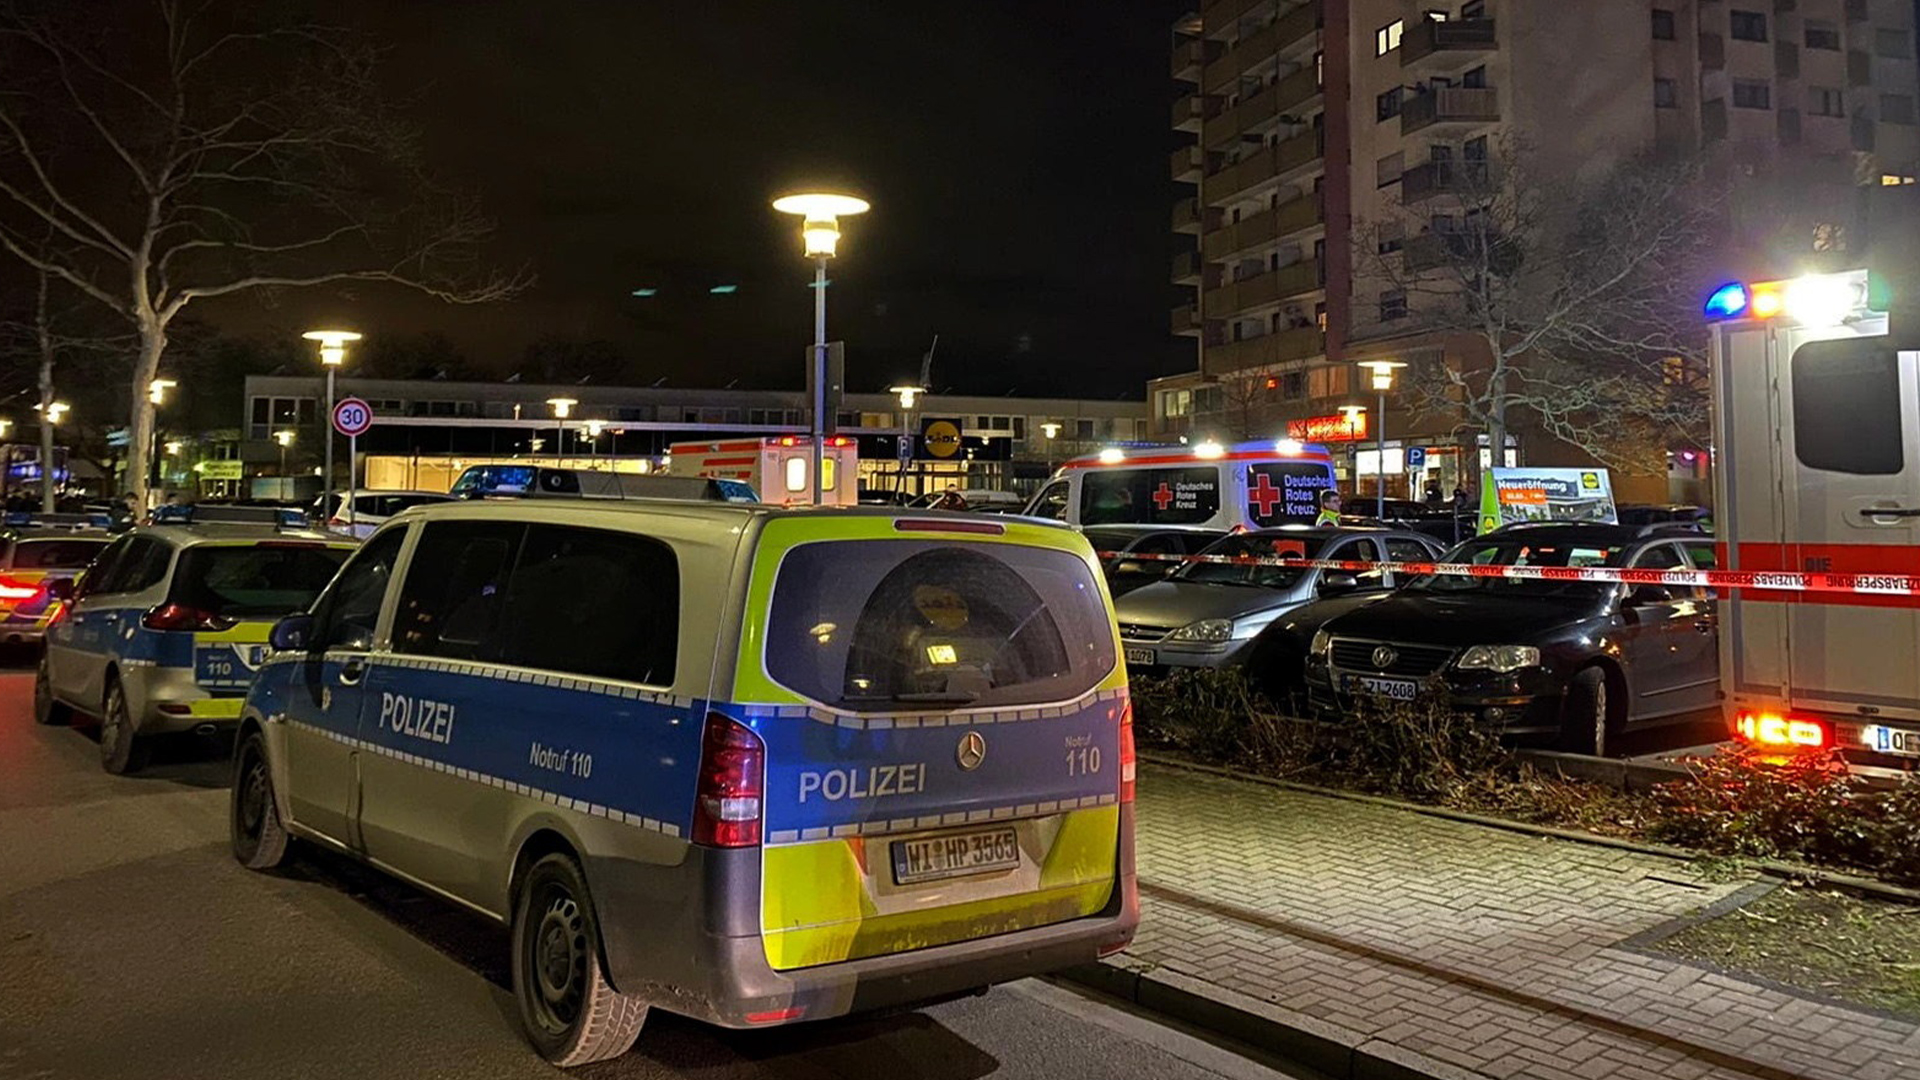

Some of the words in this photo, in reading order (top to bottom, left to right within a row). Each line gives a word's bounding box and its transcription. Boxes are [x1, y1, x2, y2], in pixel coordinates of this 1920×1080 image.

[342, 408, 363, 425] 30
[1410, 449, 1422, 463] P
[1175, 482, 1214, 491] Deutsches
[1284, 474, 1331, 487] Deutsches
[1497, 480, 1567, 494] Neueröffnung
[1175, 491, 1197, 500] Rotes
[1285, 488, 1314, 501] Rotes
[1175, 501, 1197, 509] Kreuz
[1286, 502, 1315, 515] Kreuz
[207, 662, 232, 675] 110
[1385, 682, 1414, 698] 2608
[379, 692, 455, 744] POLIZEI
[1065, 732, 1092, 748] Notruf
[529, 742, 569, 773] Notruf
[571, 752, 593, 779] 110
[1066, 746, 1101, 777] 110
[799, 763, 926, 804] POLIZEI
[908, 843, 933, 873] WI
[944, 838, 969, 868] HP
[969, 832, 1015, 864] 3565
